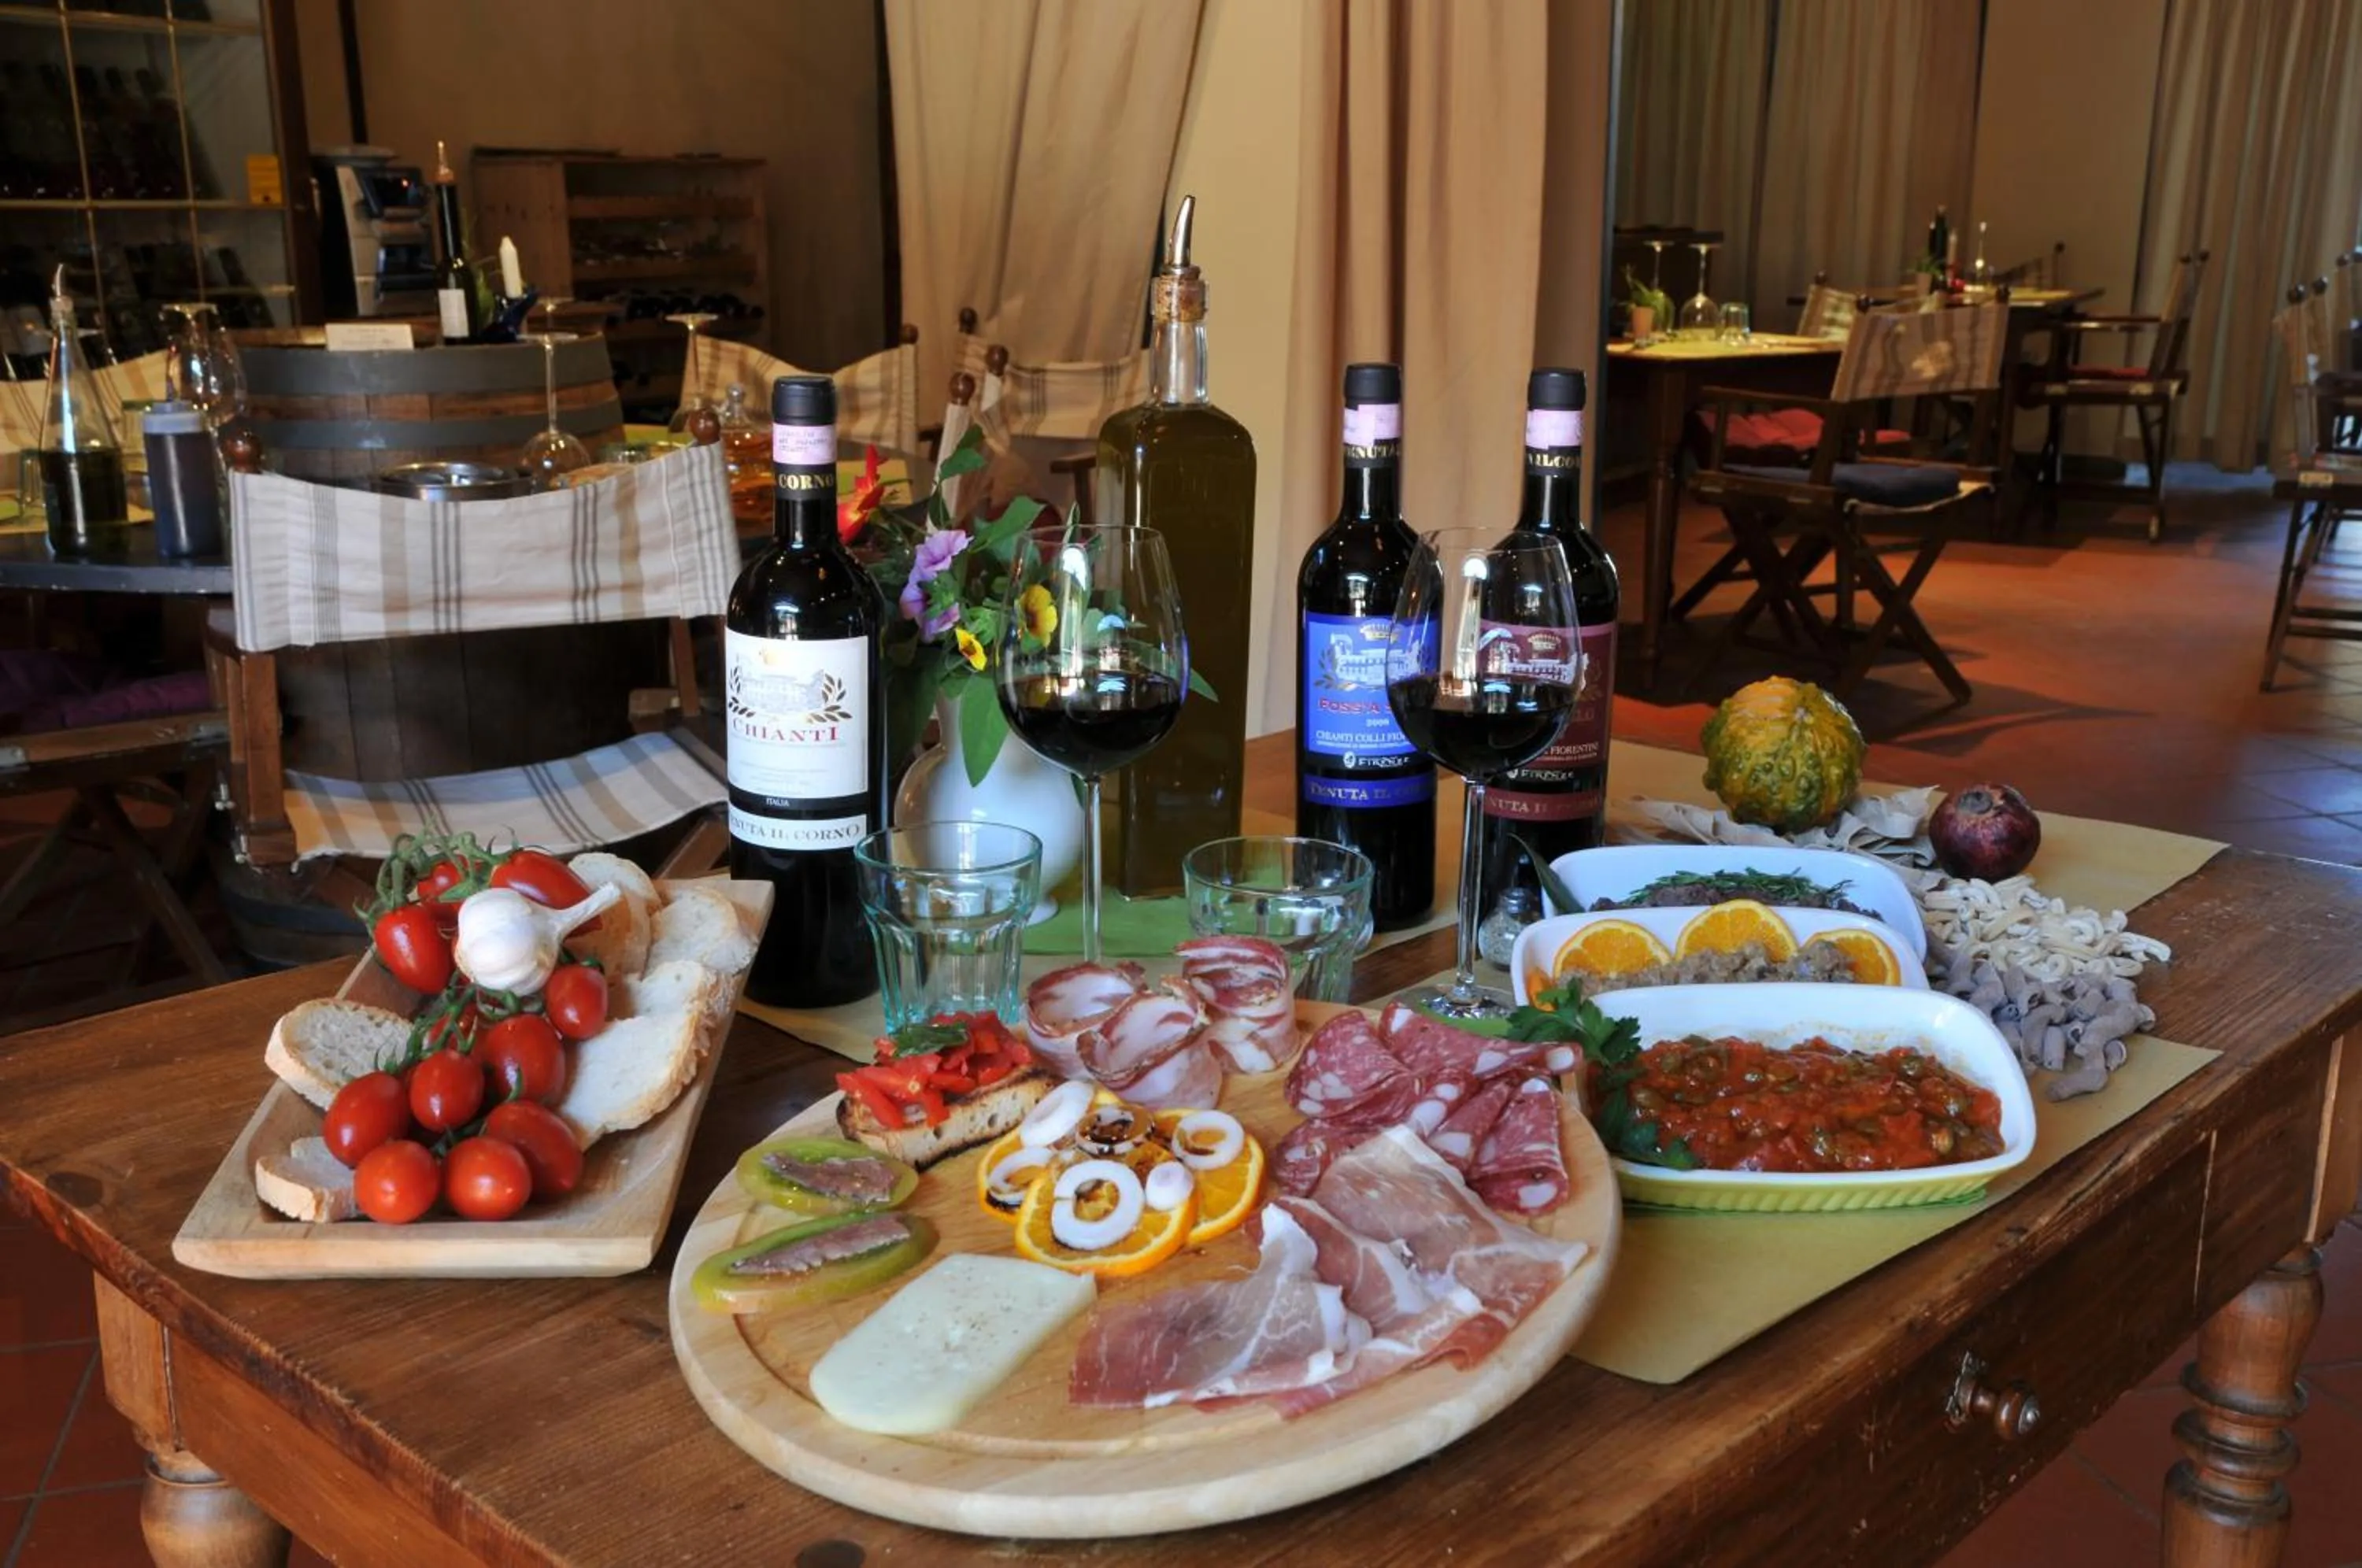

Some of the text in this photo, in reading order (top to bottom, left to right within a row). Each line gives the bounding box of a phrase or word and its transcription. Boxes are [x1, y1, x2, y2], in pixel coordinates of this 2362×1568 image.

[778, 473, 834, 490] CORNO
[732, 717, 840, 742] CHIANTI
[765, 797, 790, 808] ITALIA
[1487, 796, 1530, 813] NUTA
[793, 823, 860, 841] CORNO
